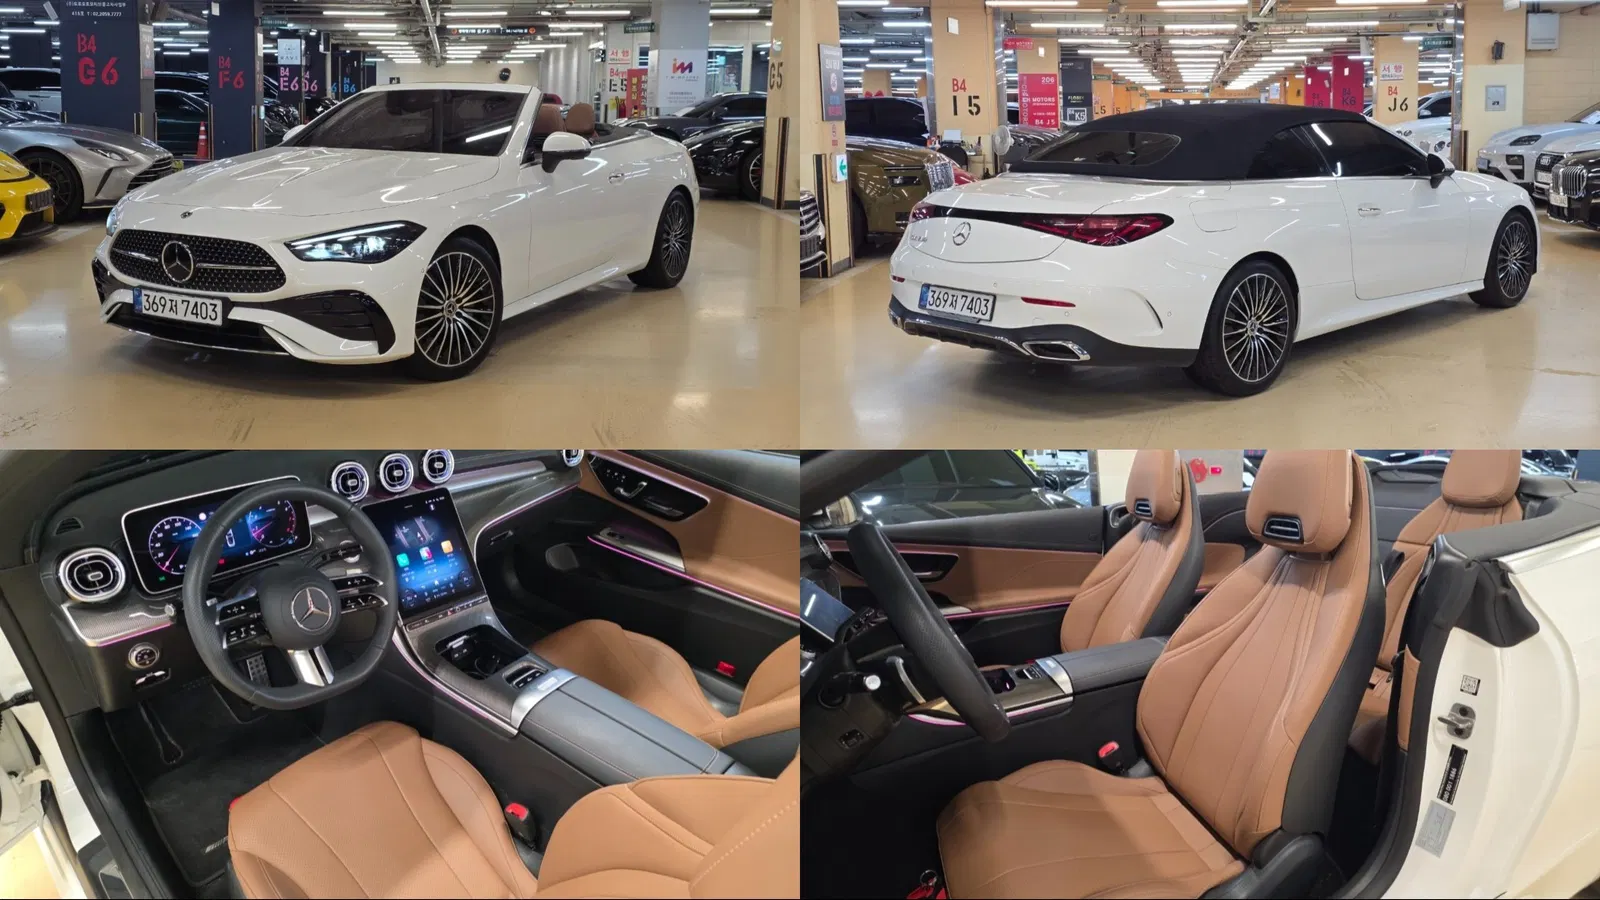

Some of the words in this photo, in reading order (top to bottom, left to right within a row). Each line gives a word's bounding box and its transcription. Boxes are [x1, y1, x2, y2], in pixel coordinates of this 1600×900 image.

[77, 32, 96, 53] B4
[218, 56, 231, 69] B4
[280, 67, 290, 77] B4
[952, 78, 967, 93] B4
[1388, 86, 1398, 96] B4
[143, 293, 178, 316] 369저
[181, 299, 218, 321] 7403
[928, 289, 959, 310] 369저
[960, 294, 990, 316] 7403
